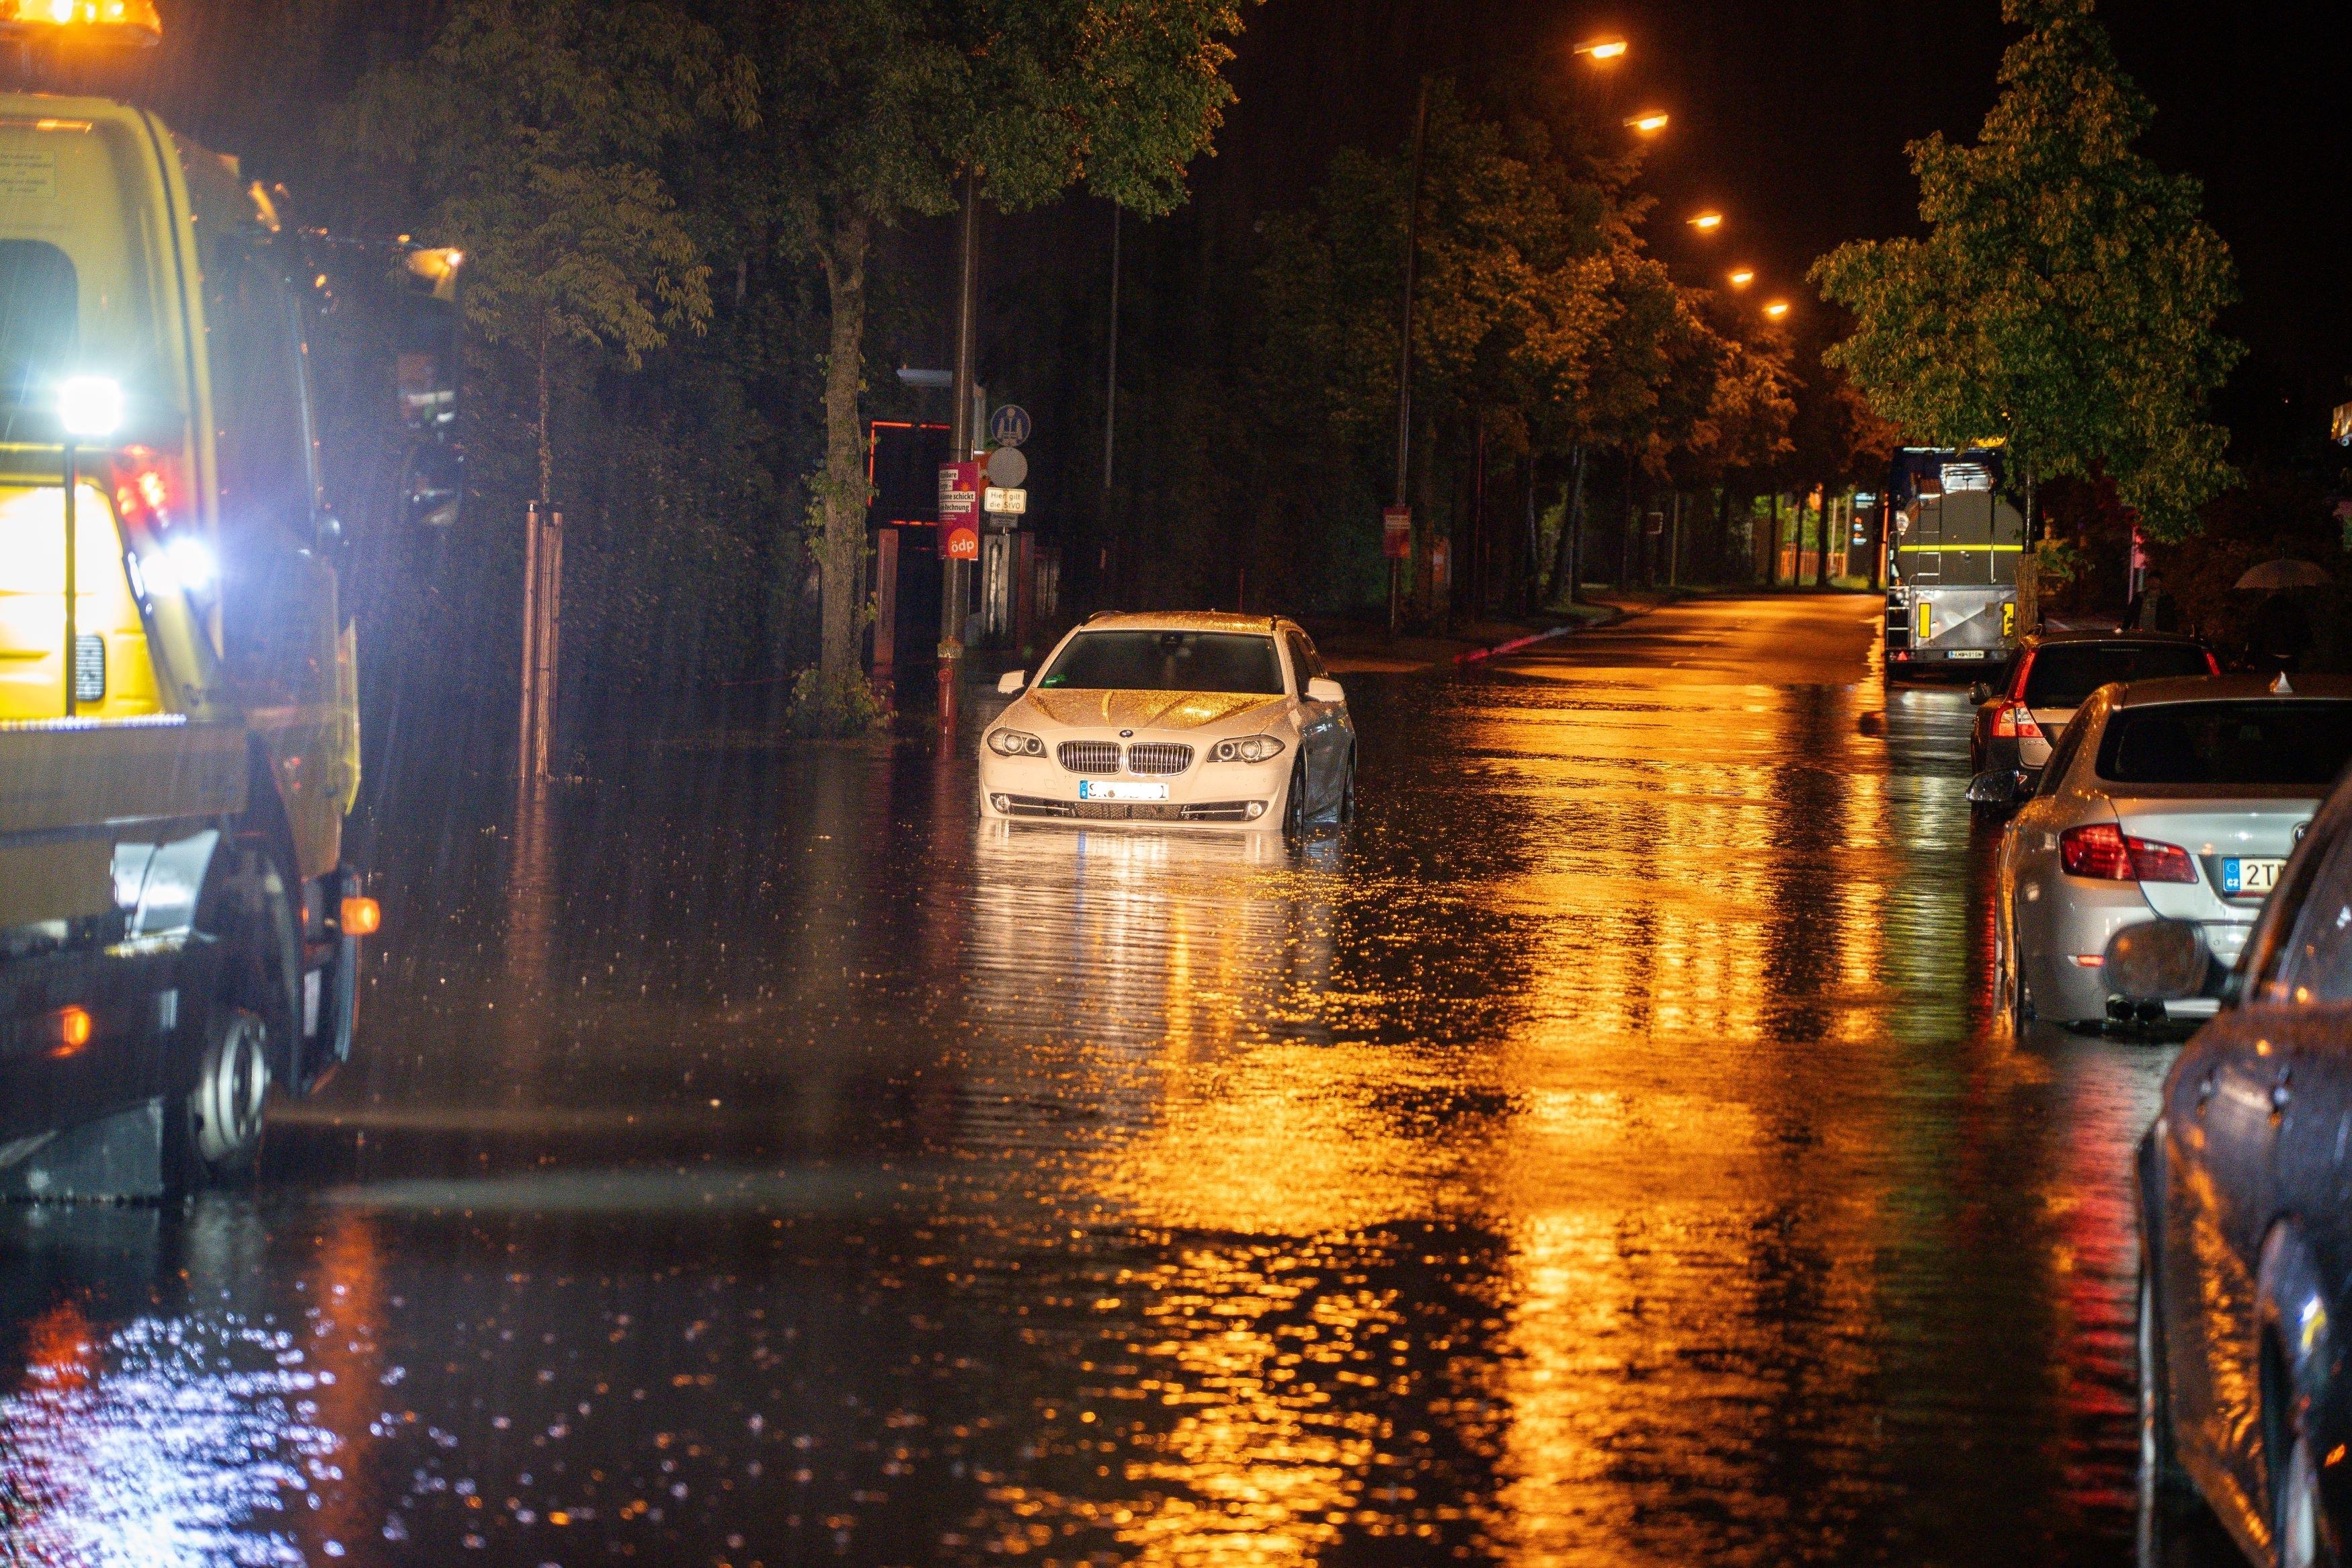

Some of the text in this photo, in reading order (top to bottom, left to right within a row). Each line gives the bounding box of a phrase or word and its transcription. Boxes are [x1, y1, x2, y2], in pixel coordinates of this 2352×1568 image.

[953, 492, 974, 500] schickt
[951, 538, 975, 553] ödp
[2226, 878, 2239, 887] CZ
